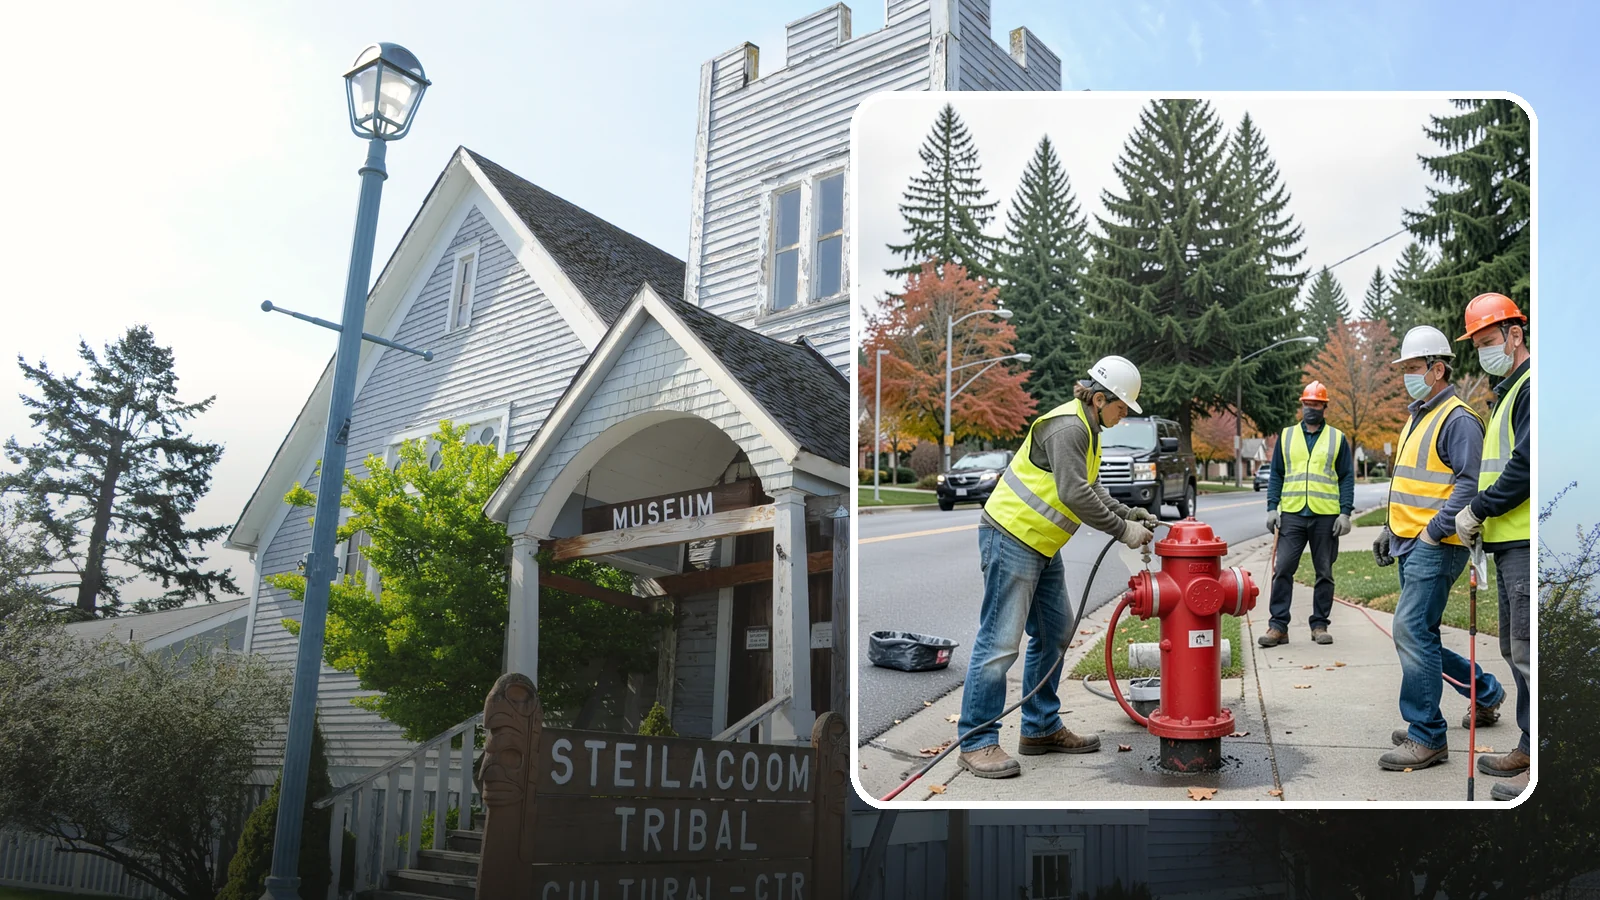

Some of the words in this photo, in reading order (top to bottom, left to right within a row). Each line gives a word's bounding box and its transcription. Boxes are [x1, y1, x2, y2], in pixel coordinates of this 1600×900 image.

[613, 491, 713, 531] MUSEUM
[550, 738, 809, 792] STEILACOOM
[614, 806, 757, 851] TRIBAL
